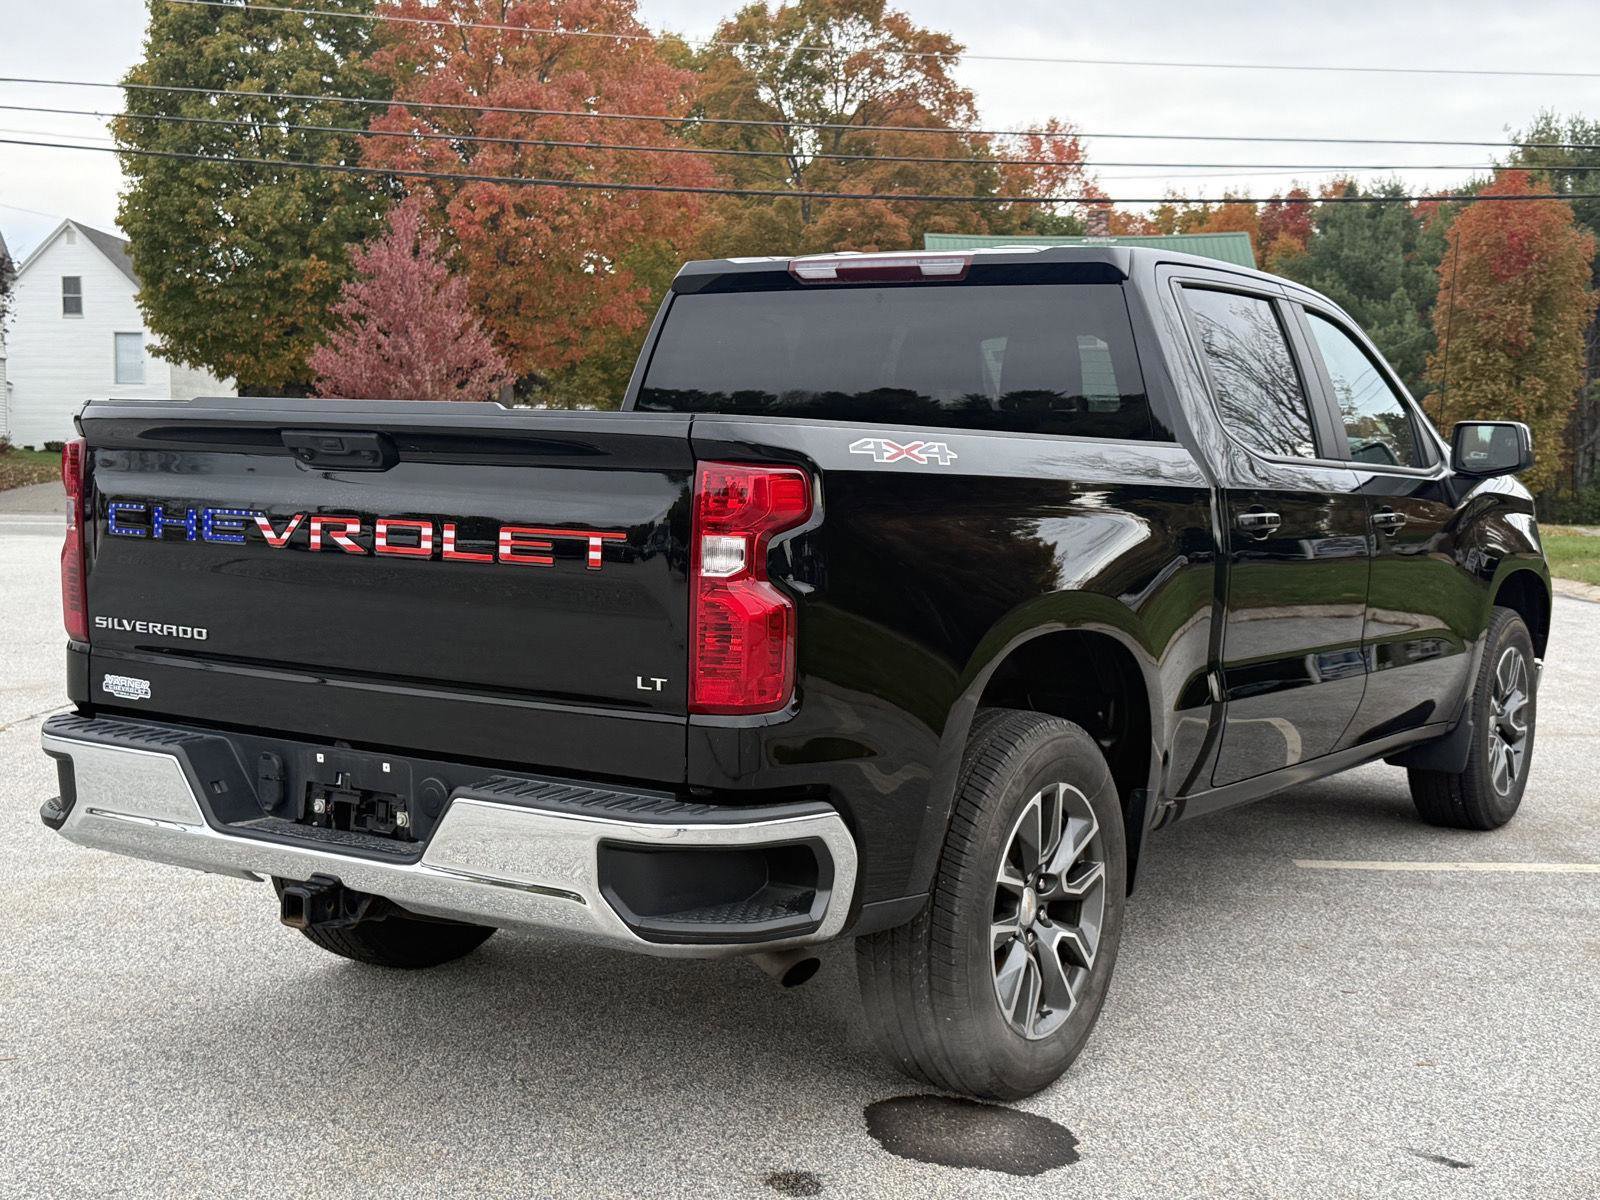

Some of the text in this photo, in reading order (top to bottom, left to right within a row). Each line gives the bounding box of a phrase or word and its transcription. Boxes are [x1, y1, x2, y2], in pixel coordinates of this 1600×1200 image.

[108, 502, 627, 570] CHEVROLET
[95, 616, 208, 640] SILVERADO
[637, 676, 667, 691] LT
